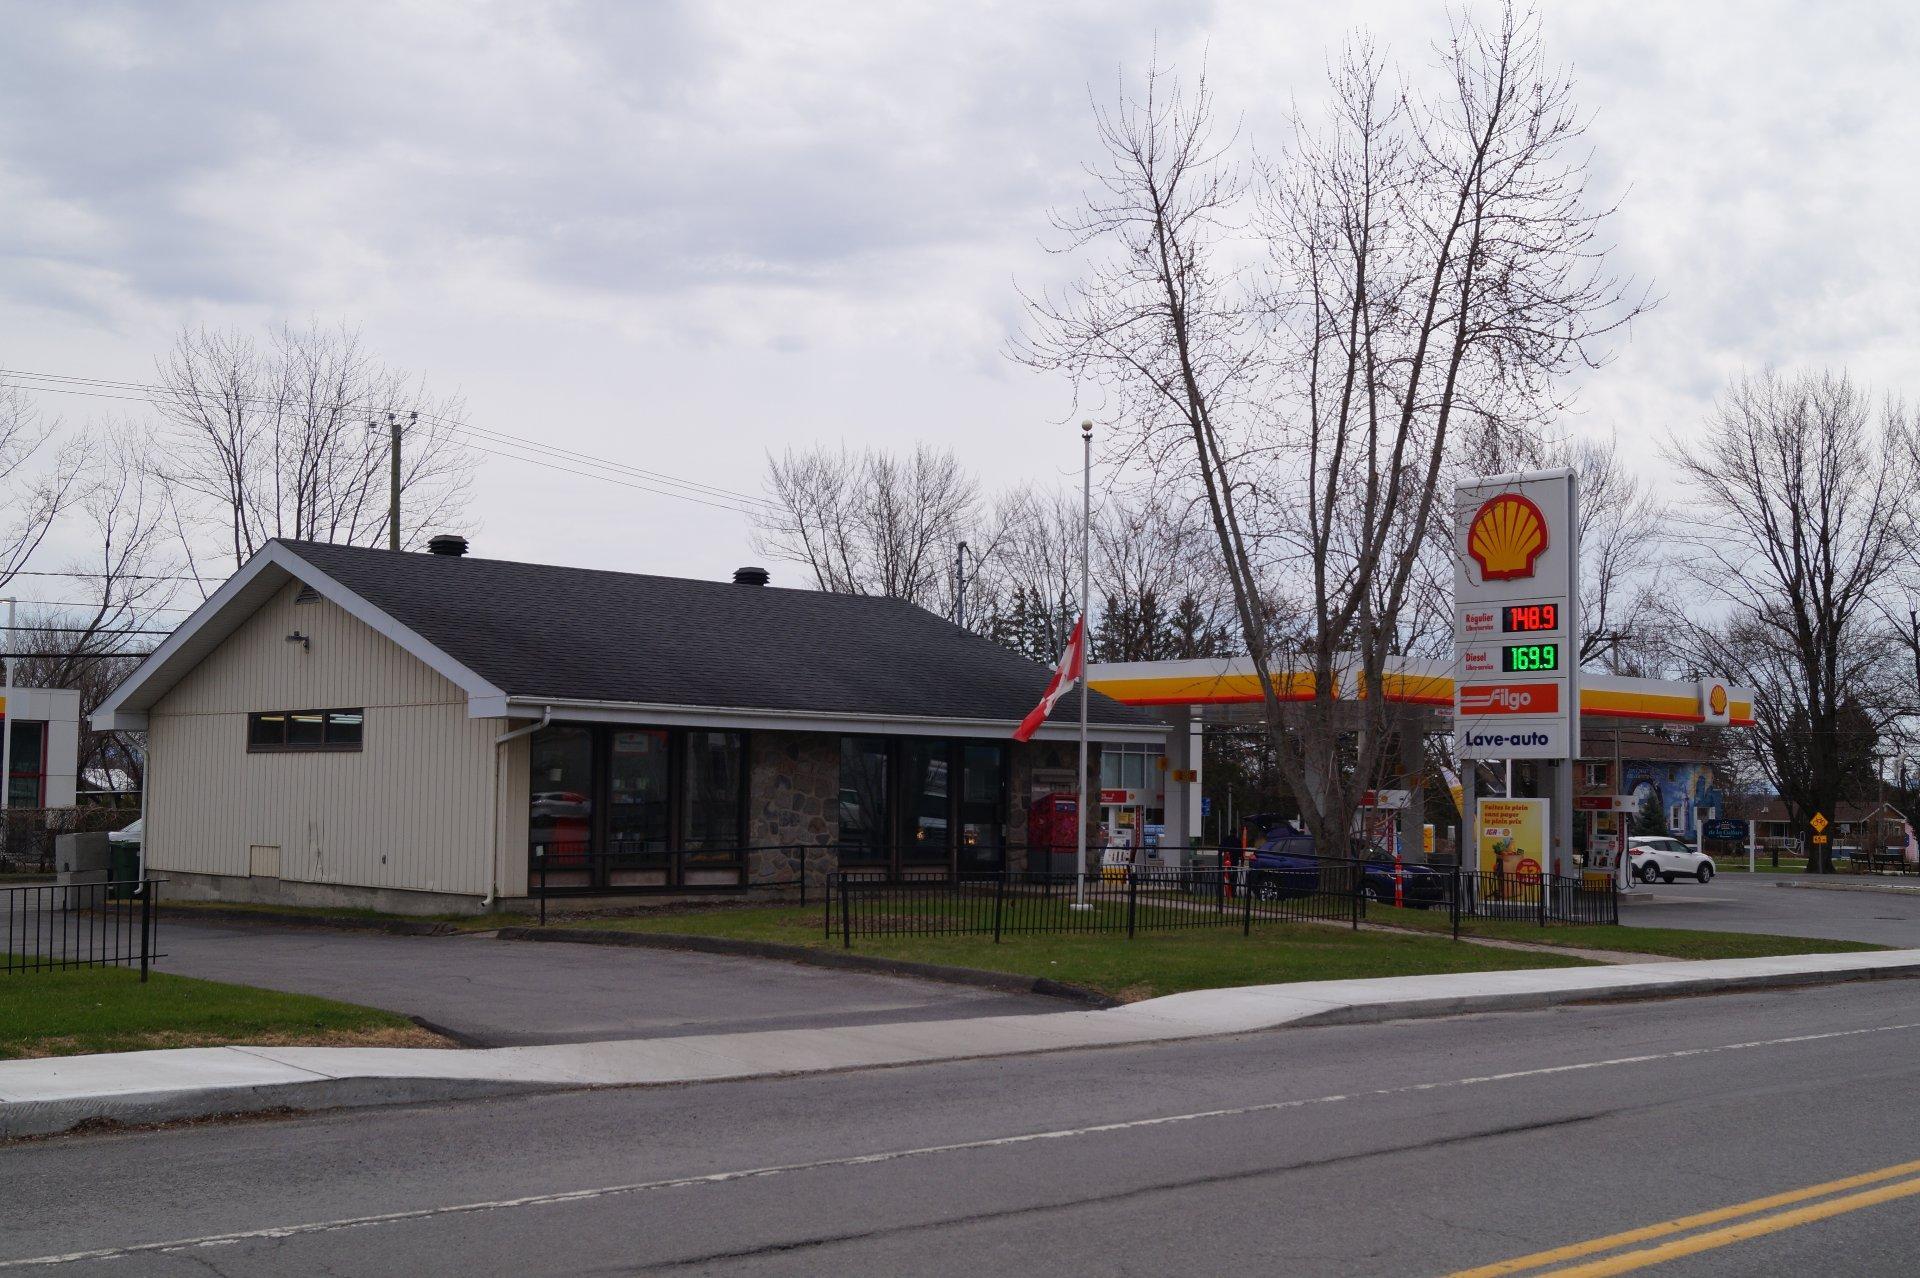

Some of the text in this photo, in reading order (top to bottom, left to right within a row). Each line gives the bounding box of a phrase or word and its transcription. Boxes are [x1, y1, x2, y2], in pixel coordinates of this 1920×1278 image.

[1511, 605, 1554, 631] 148.9
[1465, 646, 1554, 670] Diesel 169.9
[1488, 688, 1531, 711] Filgo
[1466, 731, 1549, 746] Lave-auto
